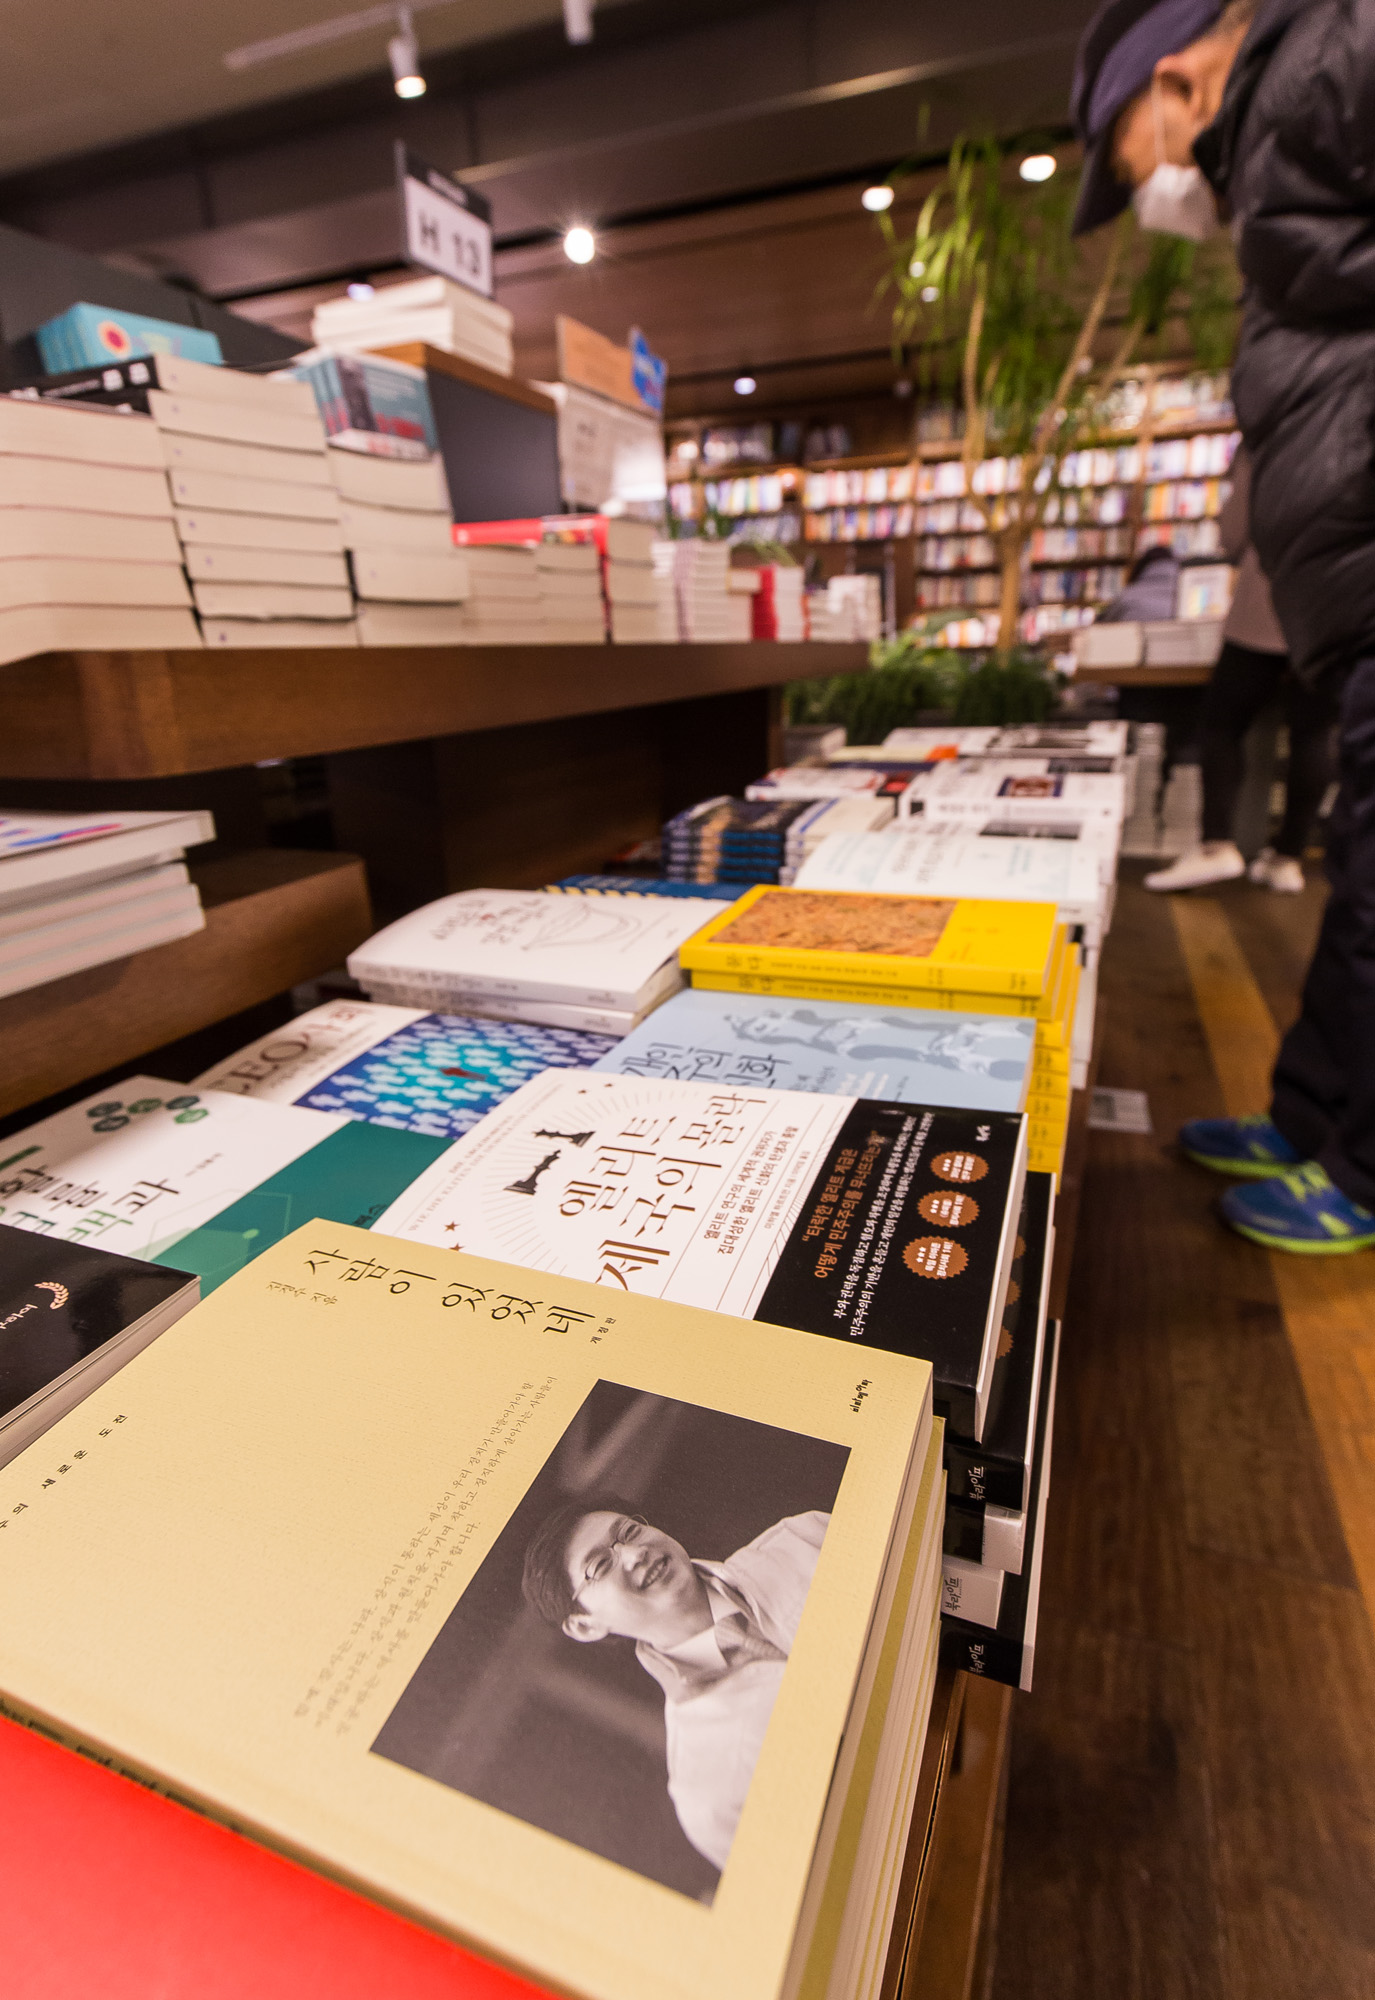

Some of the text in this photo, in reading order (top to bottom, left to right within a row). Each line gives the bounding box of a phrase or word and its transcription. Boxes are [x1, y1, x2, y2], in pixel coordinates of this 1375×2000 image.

[559, 1116, 678, 1216] 엘리트
[820, 1176, 845, 1202] 엘리트
[834, 1149, 858, 1174] 계급은
[595, 1093, 766, 1291] 제국의 몰락
[704, 1212, 729, 1240] 엘리트
[722, 1184, 746, 1209] 연구의
[717, 1216, 749, 1254] 집대성한
[739, 1189, 763, 1213] 엘리트
[755, 1163, 777, 1186] 신화의
[814, 1242, 843, 1278] 어떻게
[829, 1191, 863, 1240] 민주주의를
[872, 1240, 890, 1266] 흔들고
[880, 1219, 898, 1241] 개인의
[849, 1241, 870, 1271] 독점하고
[865, 1263, 884, 1291] 기반을
[265, 1280, 338, 1306] 김경수 지음
[303, 1248, 597, 1335] 사람이 있었네
[833, 1299, 850, 1319] 부와
[840, 1273, 860, 1299] 권력을
[590, 1317, 617, 1345] 개정판
[850, 1291, 875, 1337] 민주주의의
[41, 1450, 88, 1489] 새로운
[98, 1414, 128, 1438] 도전
[426, 1524, 453, 1561] 지키며
[451, 1491, 478, 1522] 착하고
[475, 1448, 507, 1488] 정직하게
[504, 1410, 533, 1447] 살아가는
[530, 1376, 558, 1410] 사람들이
[374, 1563, 405, 1602] 상식이
[401, 1526, 431, 1562] 통하는
[430, 1491, 456, 1524] 세상이
[452, 1468, 472, 1490] 우리
[468, 1438, 494, 1466] 정치가
[490, 1392, 526, 1436] 만들어가야
[521, 1381, 534, 1391] 할
[968, 1466, 985, 1501] 북라이프
[406, 1559, 454, 1623] 만들어가야
[450, 1521, 481, 1556] 합니다.
[944, 1577, 961, 1612] 북라이프
[968, 1644, 985, 1674] 북라이프
